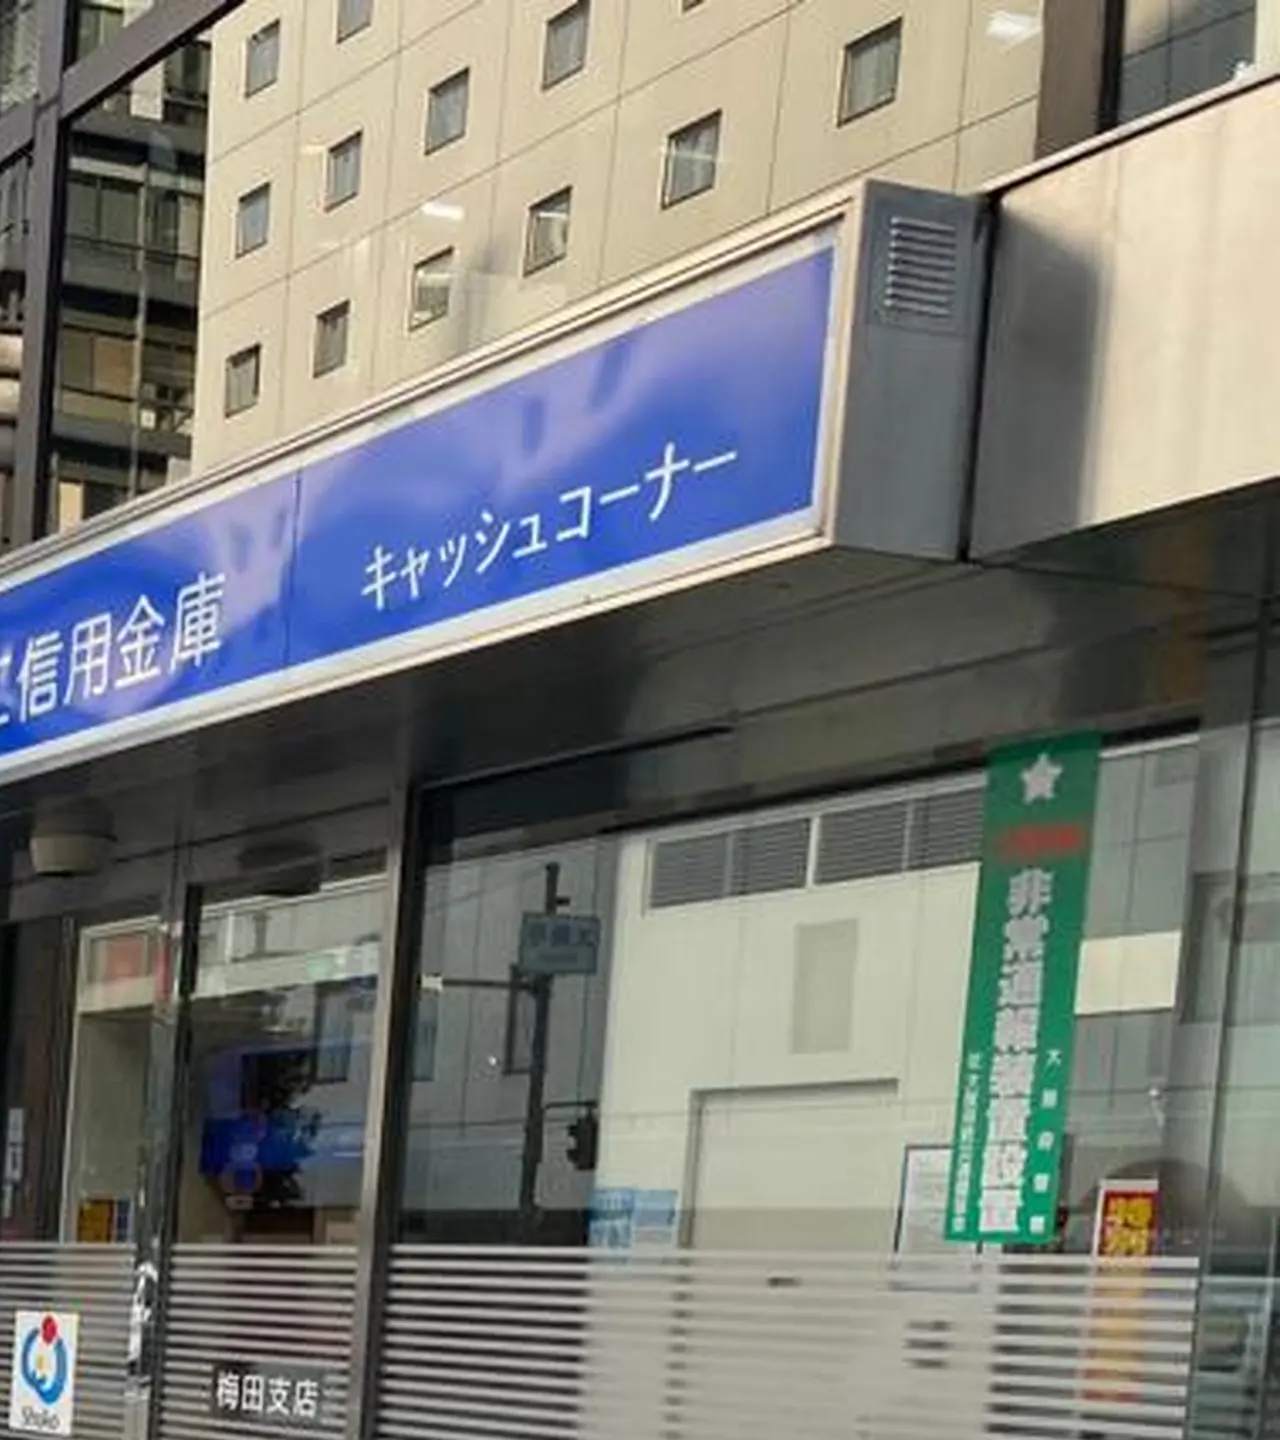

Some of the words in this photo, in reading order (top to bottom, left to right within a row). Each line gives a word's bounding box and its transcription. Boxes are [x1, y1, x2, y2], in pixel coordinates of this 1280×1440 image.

[361, 441, 738, 611] キャッシュコーナー
[217, 1370, 319, 1418] 梅田支店
